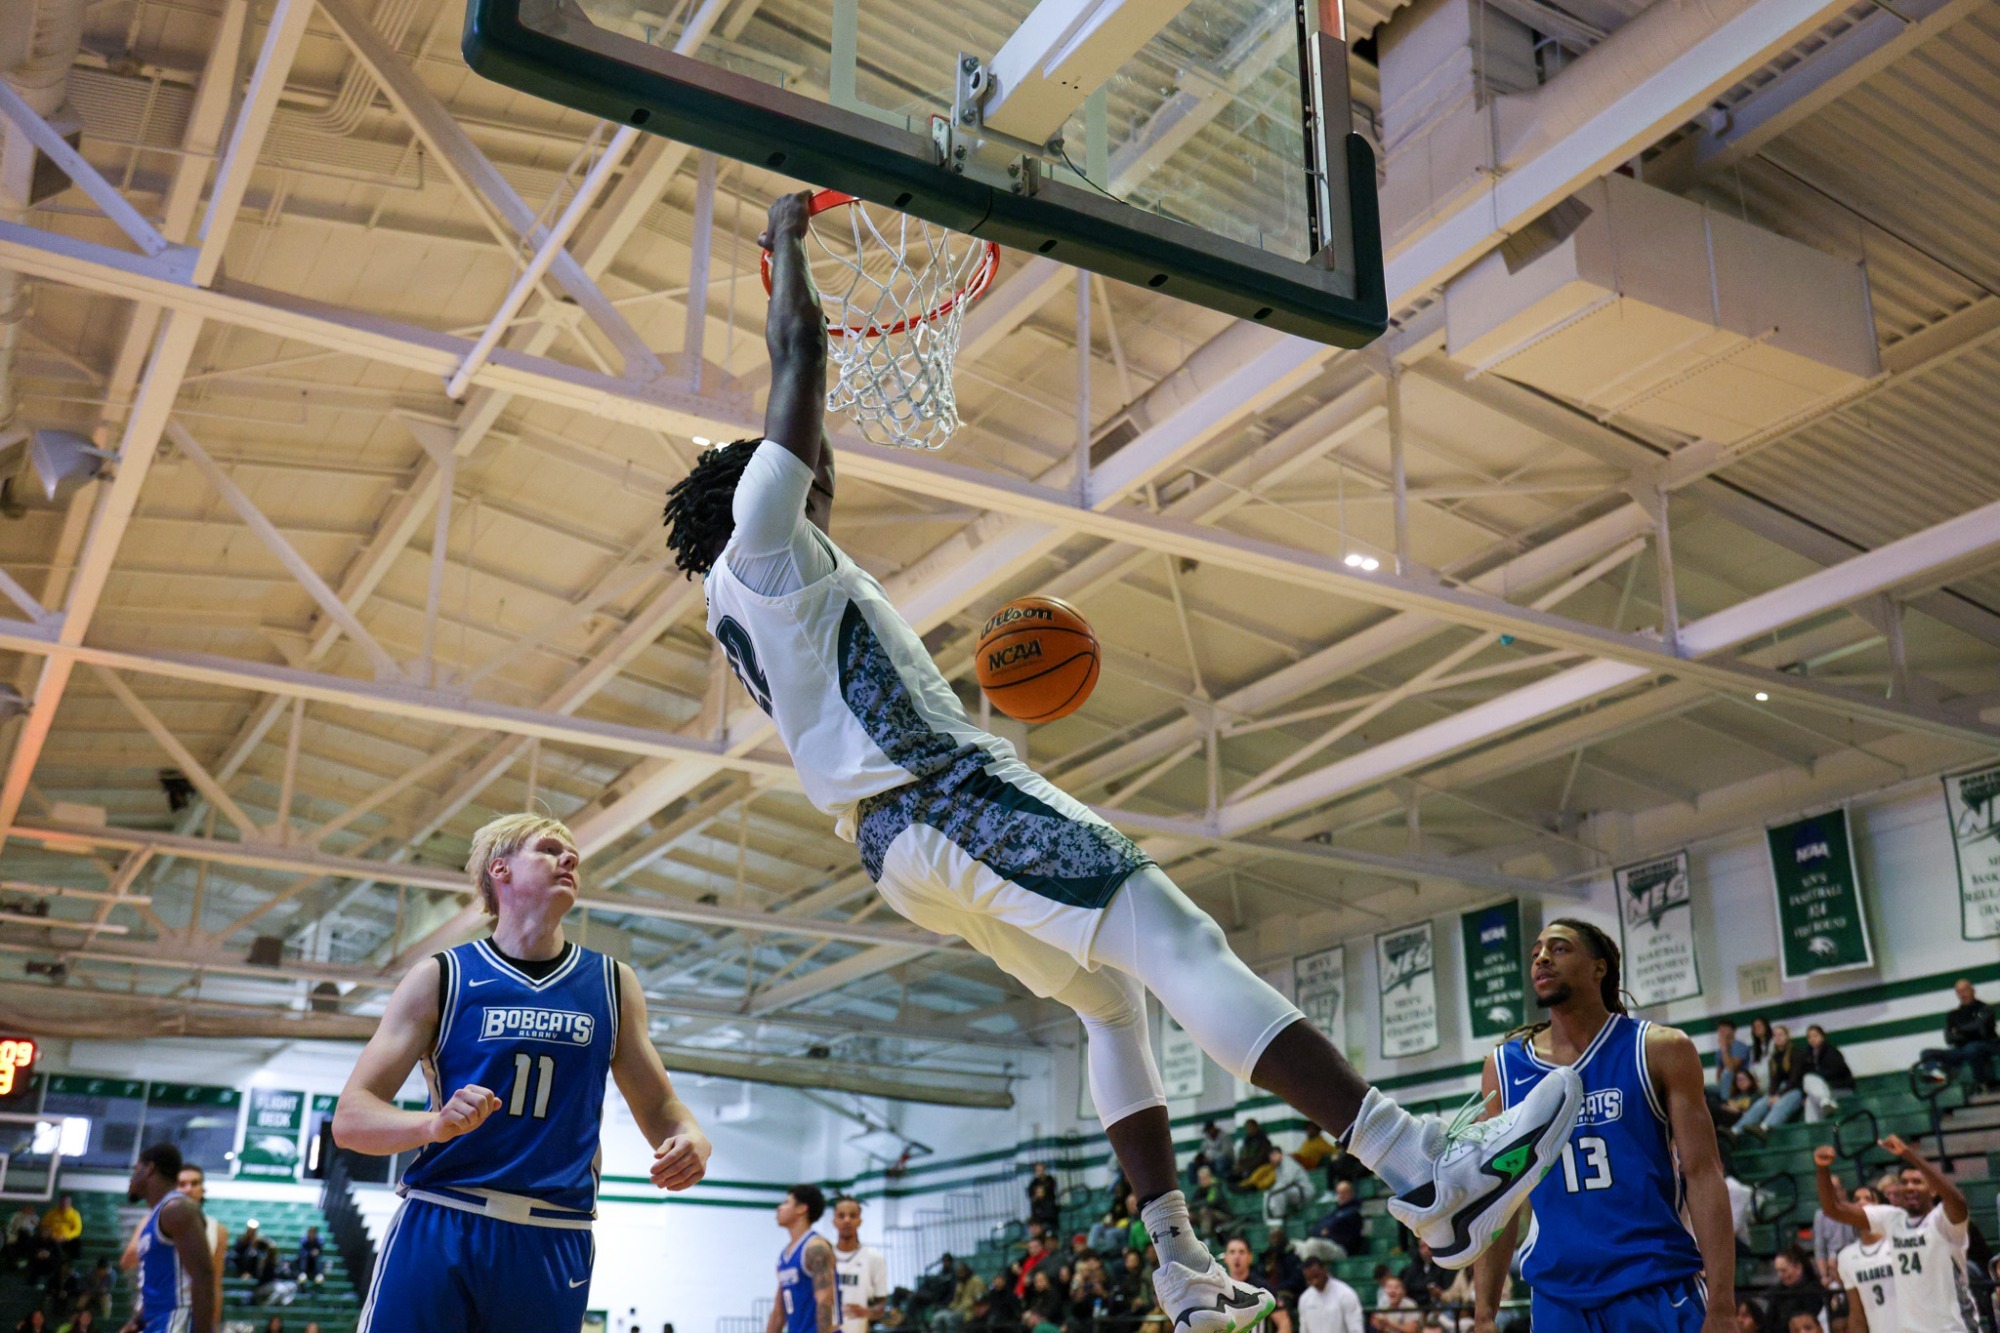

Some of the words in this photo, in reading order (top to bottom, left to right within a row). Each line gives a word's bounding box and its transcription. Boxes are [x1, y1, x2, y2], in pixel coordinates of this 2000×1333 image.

[980, 607, 1054, 640] Wilson
[988, 640, 1042, 671] NCAA
[484, 1009, 592, 1043] BOBCATS
[519, 1031, 558, 1040] ALBANY
[509, 1053, 555, 1118] 11
[1578, 1091, 1620, 1119] CATS
[1561, 1136, 1613, 1193] 13
[1898, 1252, 1922, 1275] 24
[1872, 1284, 1885, 1306] 3
